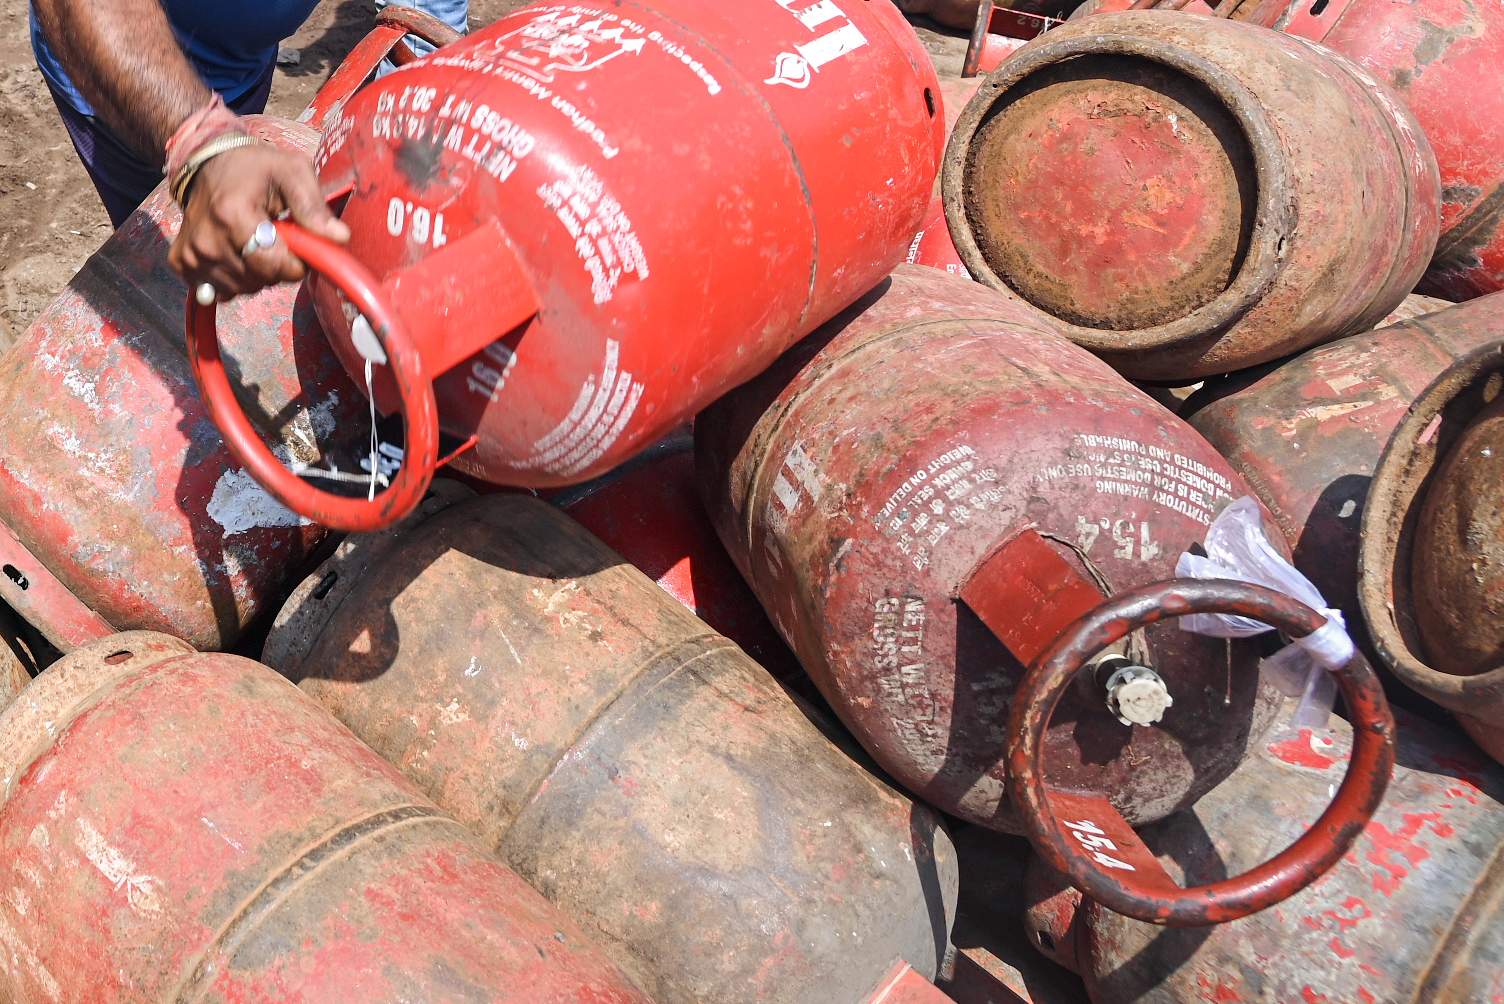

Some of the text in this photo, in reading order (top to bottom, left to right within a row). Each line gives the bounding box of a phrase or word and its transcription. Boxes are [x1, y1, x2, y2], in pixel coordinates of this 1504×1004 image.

[647, 31, 721, 95] Respecting
[386, 197, 448, 249] 16.0
[907, 485, 935, 509] SEAL
[909, 469, 928, 487] ON
[1095, 480, 1149, 499] WARNING
[1075, 514, 1158, 562] 15.4
[1062, 816, 1136, 874] 15.4
